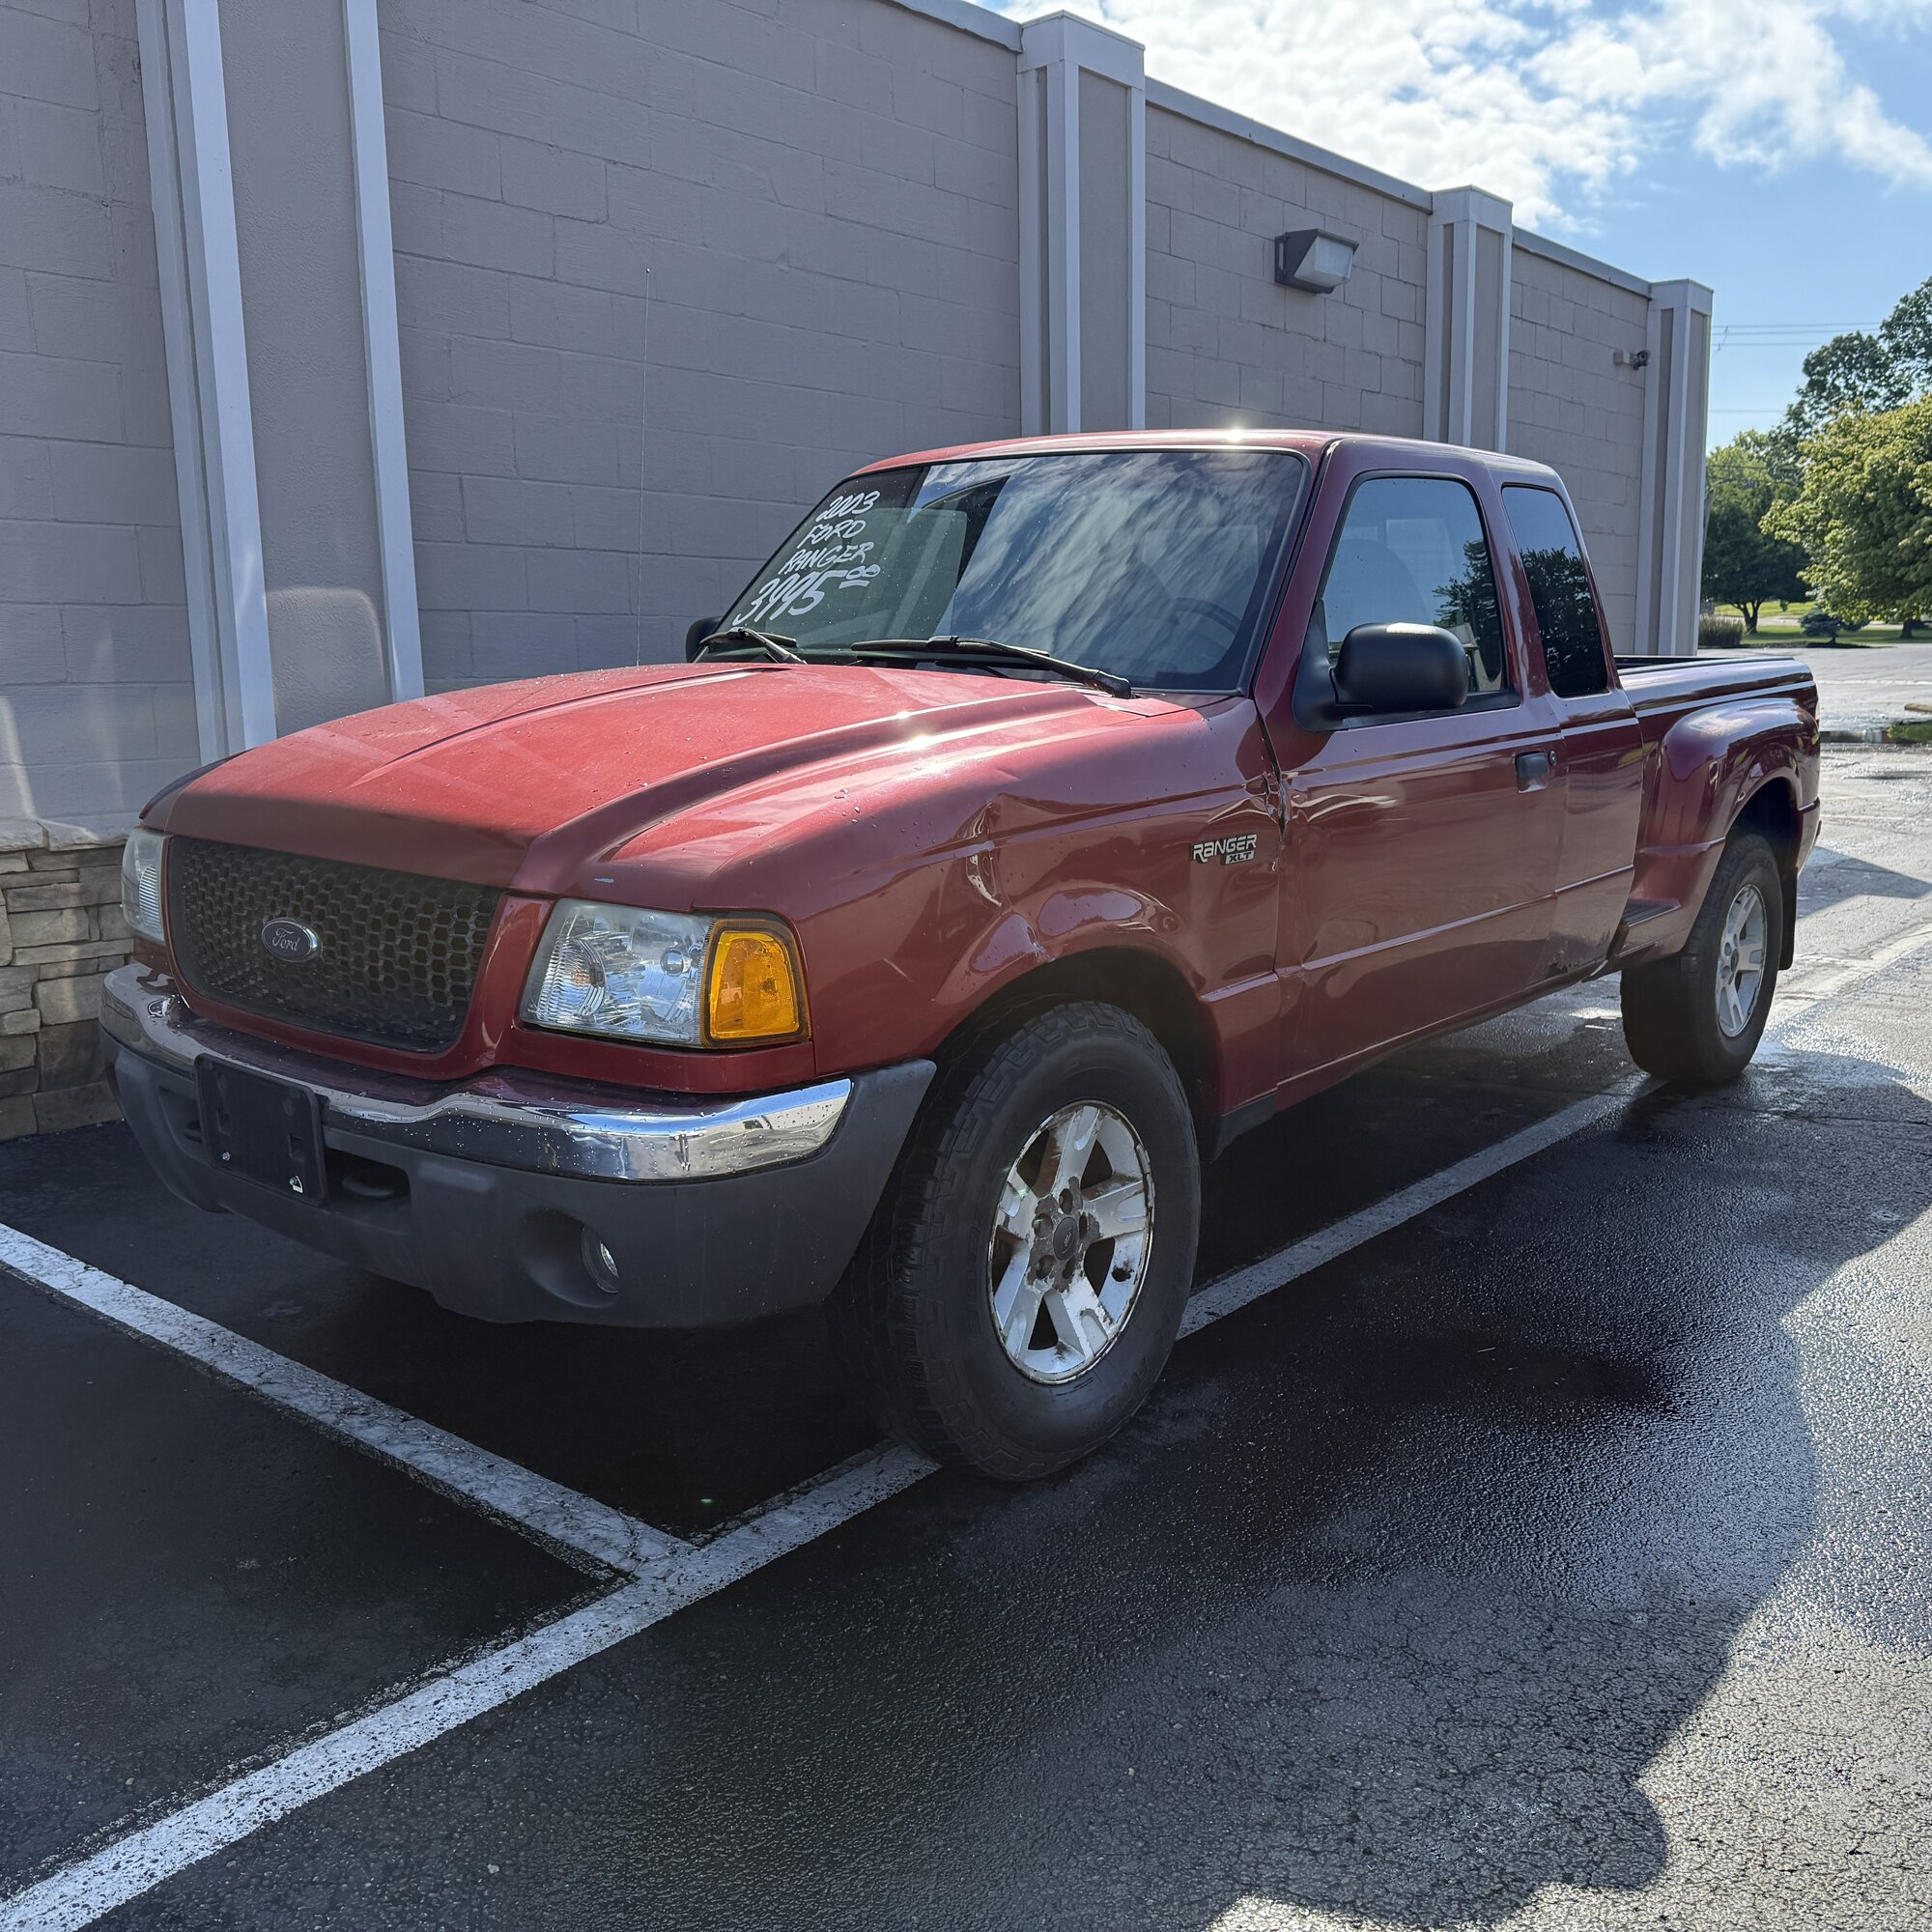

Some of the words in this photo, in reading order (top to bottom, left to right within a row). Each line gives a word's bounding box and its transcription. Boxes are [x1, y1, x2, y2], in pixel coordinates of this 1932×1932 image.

[815, 490, 880, 522] 2003
[797, 520, 866, 549] FORD
[778, 542, 874, 575] RANGER
[1230, 851, 1252, 862] XLT
[271, 927, 300, 952] Ford
